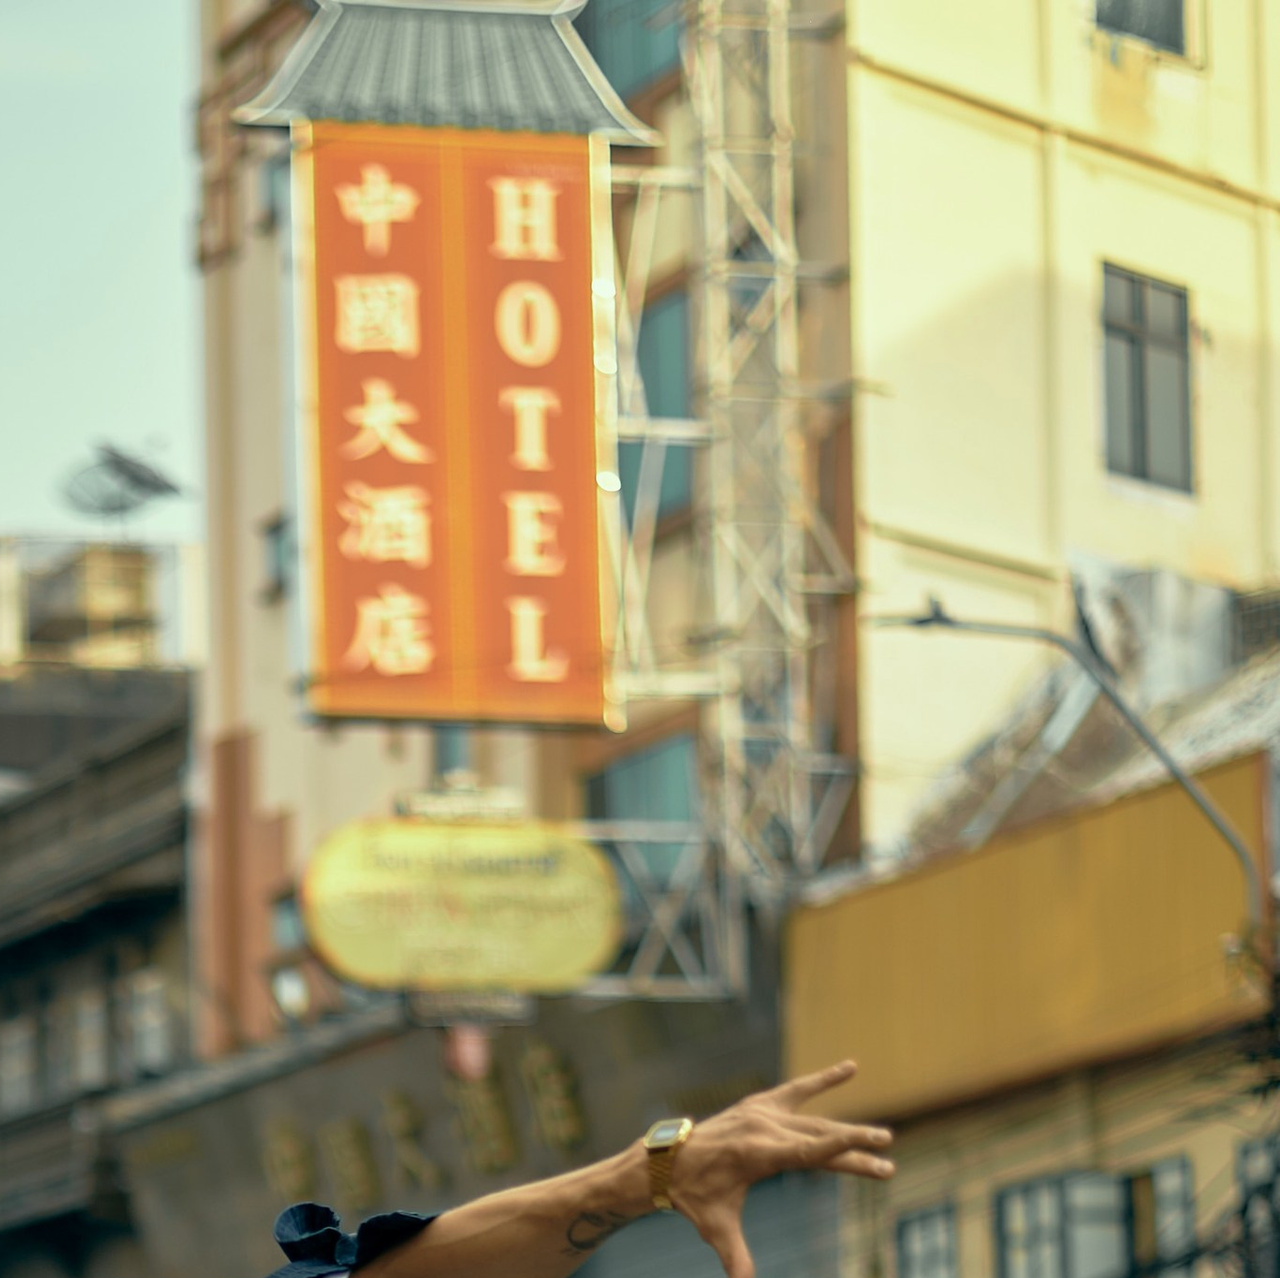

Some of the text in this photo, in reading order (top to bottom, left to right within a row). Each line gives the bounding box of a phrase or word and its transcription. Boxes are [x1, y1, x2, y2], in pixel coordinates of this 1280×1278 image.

[333, 160, 436, 677] 中國大酒店
[489, 174, 569, 684] HOTEL
